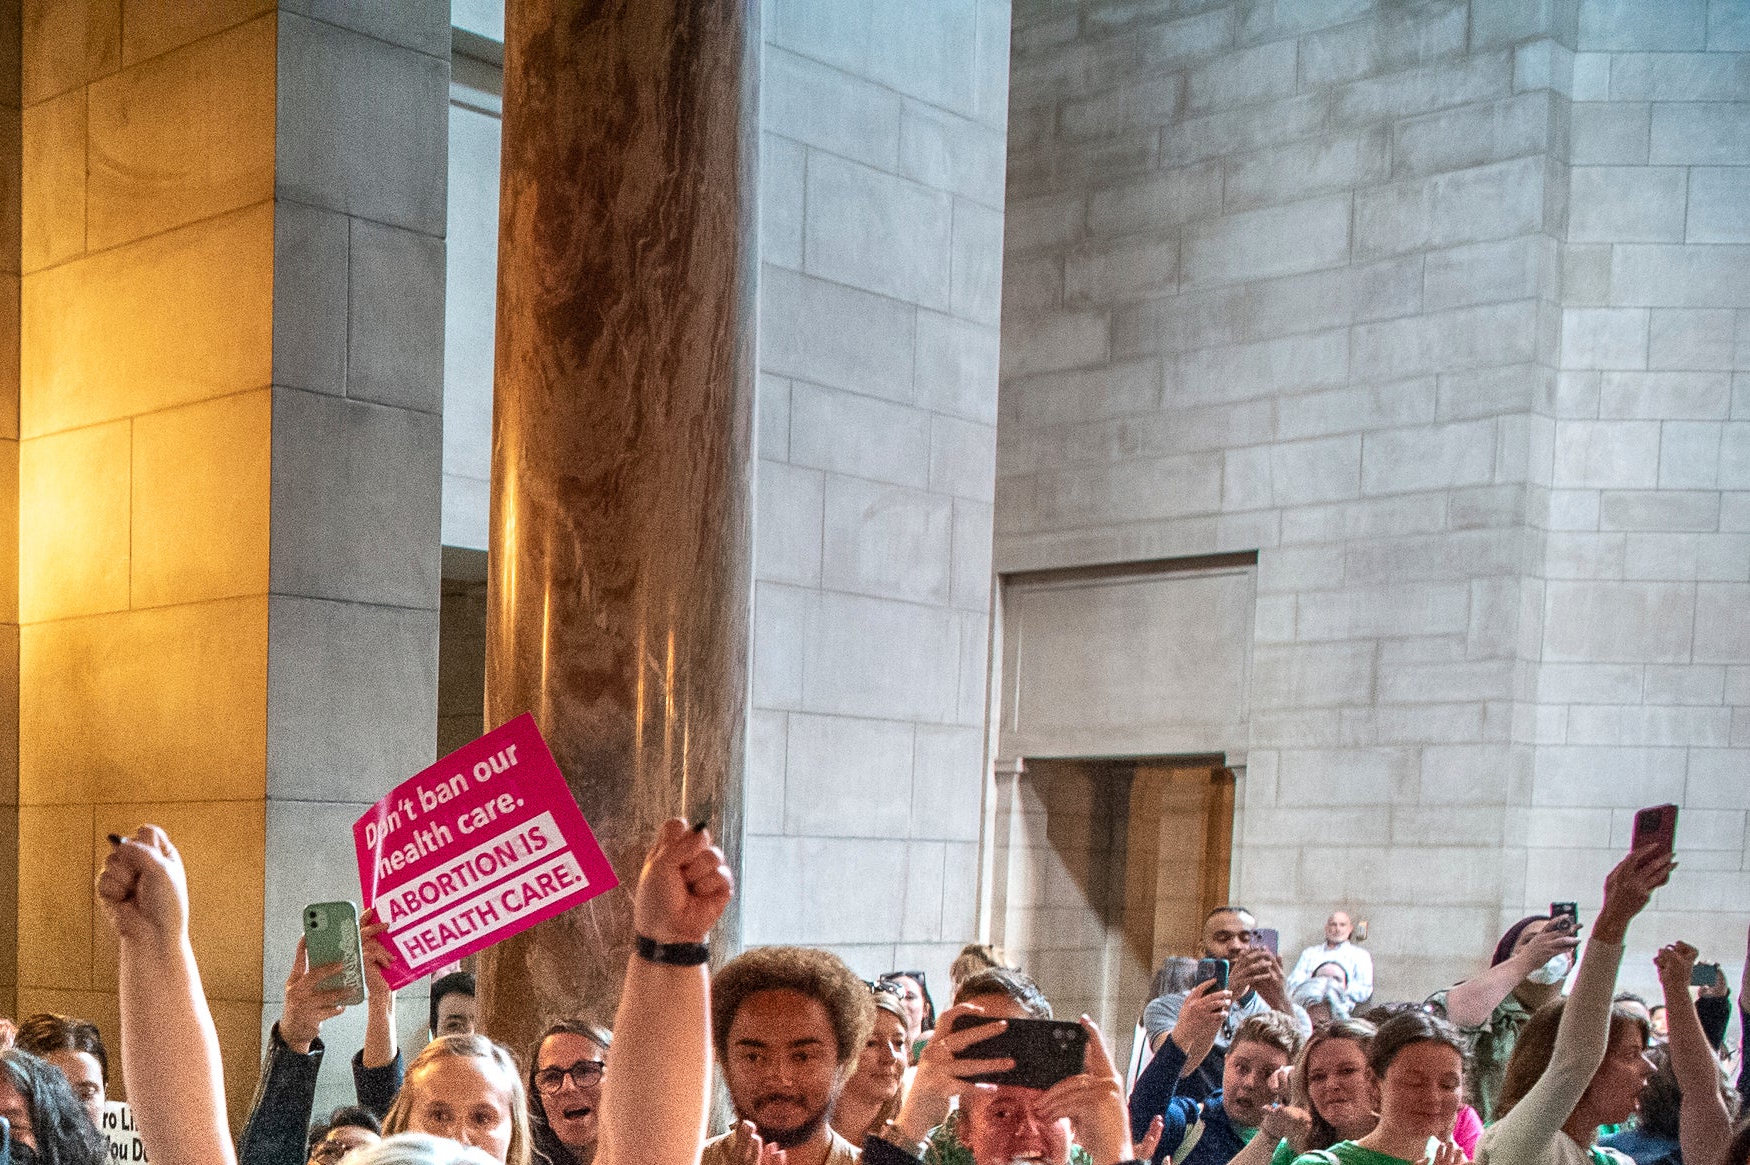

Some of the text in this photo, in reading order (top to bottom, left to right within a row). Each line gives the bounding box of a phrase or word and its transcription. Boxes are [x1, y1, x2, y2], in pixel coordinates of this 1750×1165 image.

[365, 744, 519, 850] Don't ban our
[378, 791, 525, 880] health care.
[389, 826, 549, 923] ABORTION IS
[402, 865, 582, 960] HEALTH CARE.
[103, 1112, 117, 1129] ro
